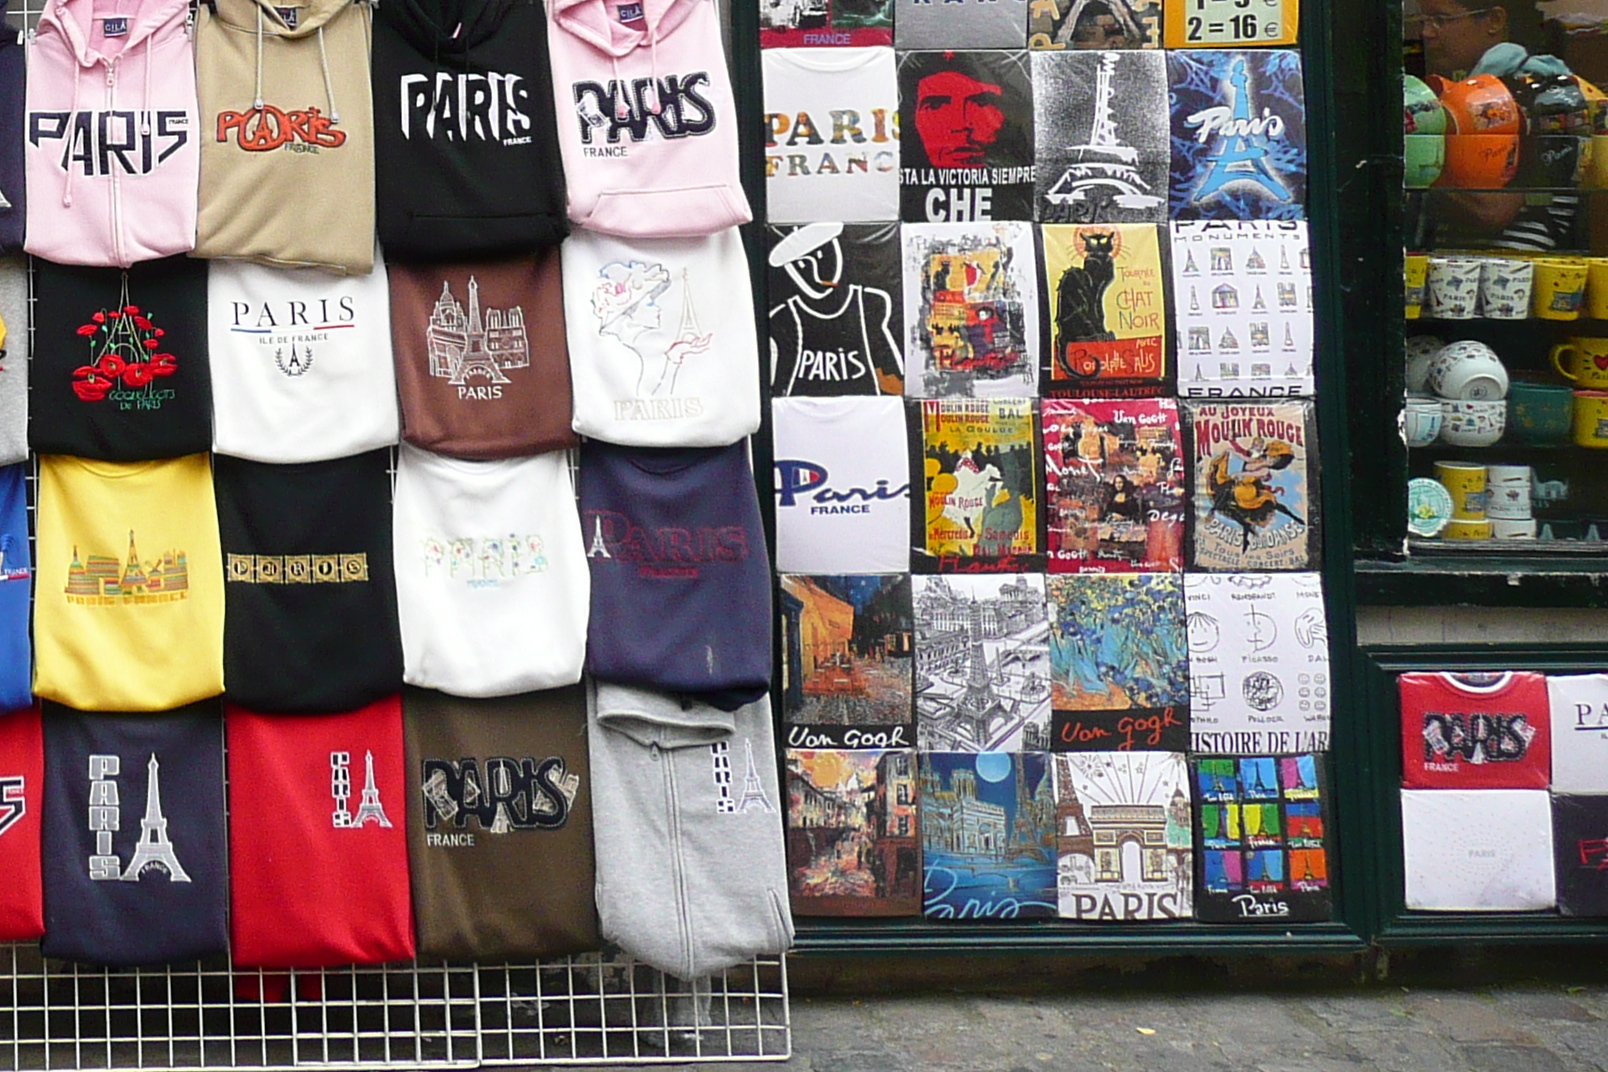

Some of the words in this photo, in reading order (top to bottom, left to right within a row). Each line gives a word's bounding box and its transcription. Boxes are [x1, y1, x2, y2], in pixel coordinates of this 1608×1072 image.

[803, 33, 851, 46] FRANCE
[400, 71, 532, 142] PARIS
[572, 70, 718, 145] PARIS
[216, 103, 347, 153] PARIS
[1186, 107, 1285, 143] Paris
[30, 109, 188, 177] PARIS
[502, 135, 533, 147] FRANCE
[583, 145, 630, 159] FRANCE
[921, 169, 936, 185] LA
[939, 168, 989, 186] VICTORIA
[991, 166, 1037, 185] SIEMPRE
[925, 187, 992, 222] CHE
[1174, 232, 1301, 243] MONUMENTS
[230, 296, 356, 327] PARIS
[1116, 288, 1154, 313] CHAT
[1118, 310, 1161, 331] NOIR
[276, 334, 289, 344] DE
[292, 332, 330, 344] FRANCE
[457, 385, 503, 399] PARIS
[1187, 385, 1303, 398] FRANCE
[613, 397, 704, 421] PARIS
[998, 407, 1024, 420] BAL
[1199, 406, 1217, 417] AU
[1221, 406, 1275, 421] JOYEUX
[949, 425, 962, 434] LA
[1195, 418, 1257, 457] MOULIN
[1260, 419, 1303, 447] ROUGE
[810, 503, 871, 516] FRANCE
[928, 496, 957, 508] MOULIN
[958, 496, 984, 510] ROUGE
[583, 510, 749, 564] PARIS
[1204, 517, 1244, 548] PARIS
[1267, 731, 1290, 754] DE
[1422, 711, 1528, 764] PARIS
[1423, 762, 1460, 772] FRANCE
[422, 756, 567, 833] PARIS
[88, 754, 121, 881] PARIS
[426, 833, 476, 847] FRANCE
[1468, 848, 1497, 859] PARIS
[1071, 892, 1178, 920] PARIS
[1231, 894, 1290, 917] Paris
